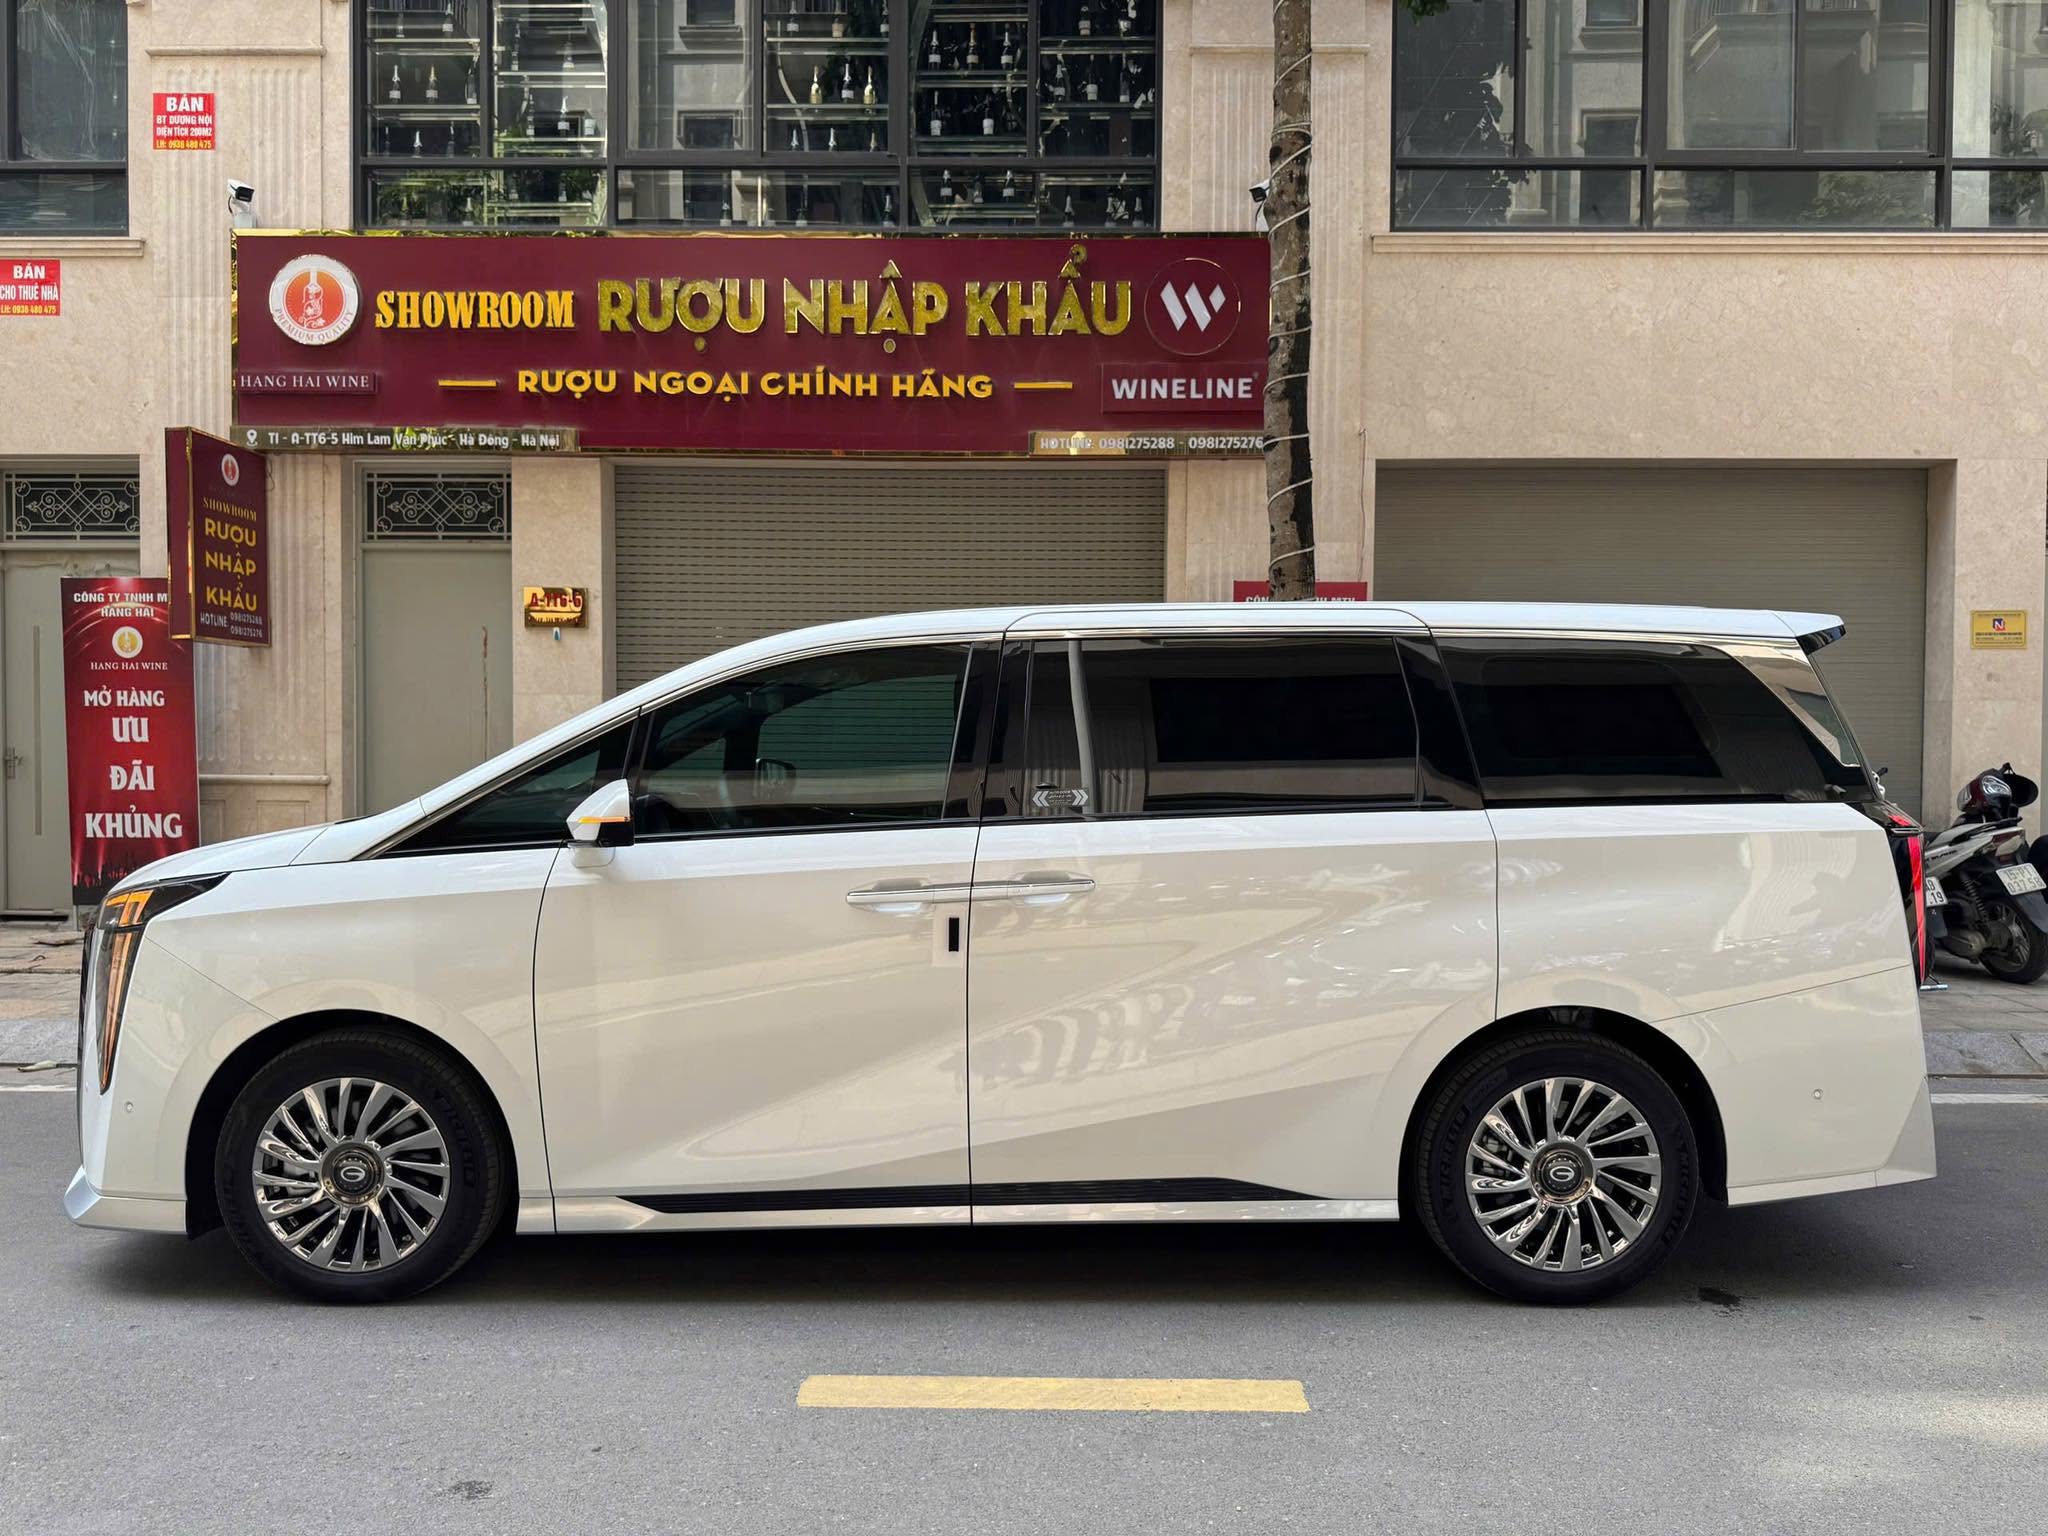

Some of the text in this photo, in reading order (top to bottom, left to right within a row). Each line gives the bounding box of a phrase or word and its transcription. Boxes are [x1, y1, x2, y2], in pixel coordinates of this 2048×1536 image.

[166, 94, 204, 112] BÁN
[13, 262, 46, 280] BÁN
[0, 285, 16, 300] CHO
[41, 282, 59, 301] NHÀ
[597, 243, 1131, 354] RƯỢU NHẬP KHẨU
[375, 290, 575, 329] SHOWROOM
[275, 308, 354, 342] PREMIUM QUALITY
[240, 375, 369, 388] HANG HAI WINE
[518, 366, 993, 402] RƯỢU NGOẠI CHÍNH HÃNG
[1111, 378, 1253, 400] WINELINE
[291, 432, 339, 446] A-TT6-5
[341, 432, 364, 445] Him
[367, 432, 391, 445] Lam
[1100, 436, 1175, 449] 0981275288
[1188, 436, 1264, 449] 0981275276
[203, 496, 257, 522] SHOWROOM
[205, 517, 257, 549] RƯỢU
[205, 550, 257, 580] NHẬP
[73, 591, 105, 603] CÔNG
[108, 593, 120, 602] TY
[124, 593, 154, 602] TNHH
[206, 582, 257, 612] KHẨU
[91, 662, 168, 670] HANG HAI WINE
[83, 684, 165, 707] MỞ HÀNG
[112, 715, 149, 742] ƯU
[110, 759, 155, 790] ĐÃI
[85, 804, 183, 838] KHỦNG
